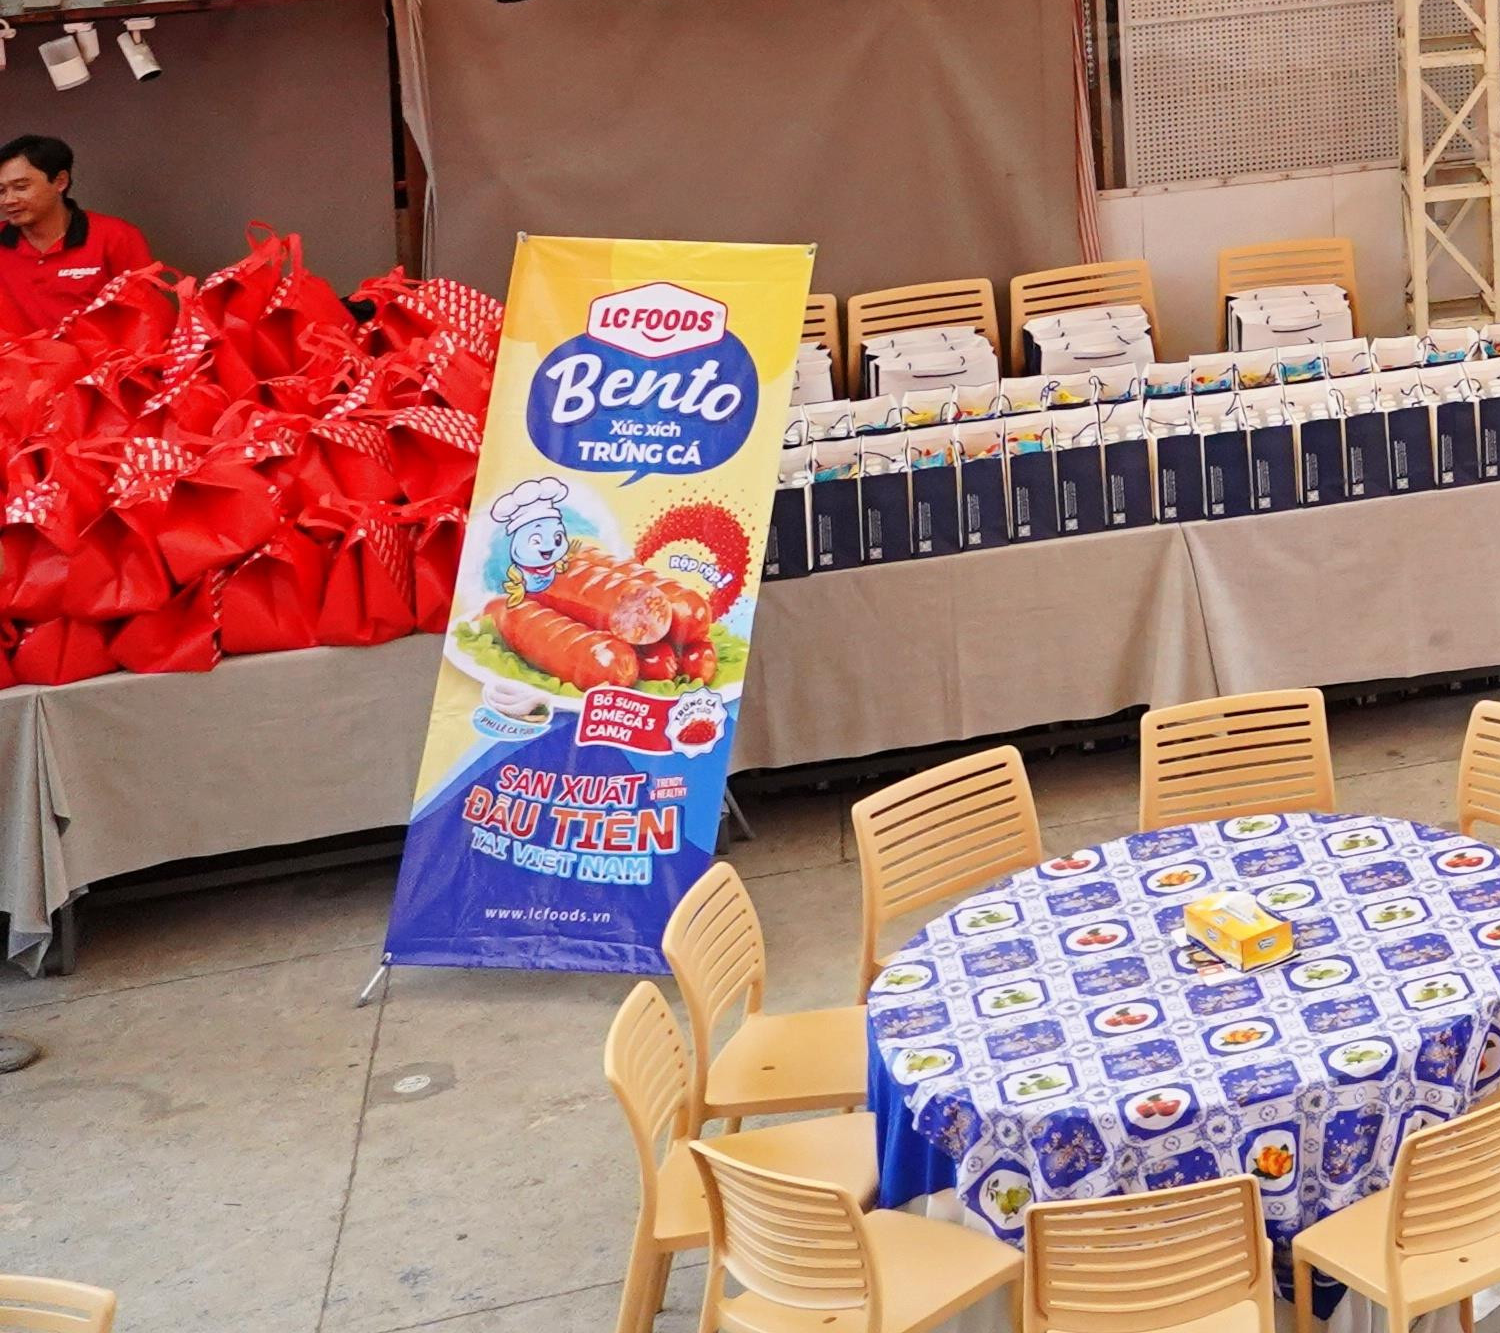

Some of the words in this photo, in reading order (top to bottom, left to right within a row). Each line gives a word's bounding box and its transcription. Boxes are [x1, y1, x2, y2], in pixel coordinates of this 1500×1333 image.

[600, 307, 630, 329] LC
[631, 308, 714, 332] FOODS
[545, 353, 742, 424] Bento
[609, 419, 644, 437] Xúc
[644, 420, 682, 438] xích
[578, 438, 663, 465] TRỨNG
[666, 440, 702, 466] CÁ
[669, 555, 698, 573] Rộp
[615, 697, 650, 717] sung
[590, 708, 644, 729] OMEGA
[645, 718, 656, 731] 3
[585, 724, 632, 743] CANXI
[656, 786, 688, 800] HEALTHY
[551, 805, 678, 855] TIÊN
[577, 854, 652, 885] NAM
[484, 905, 611, 924] www.lcfoods.vn
